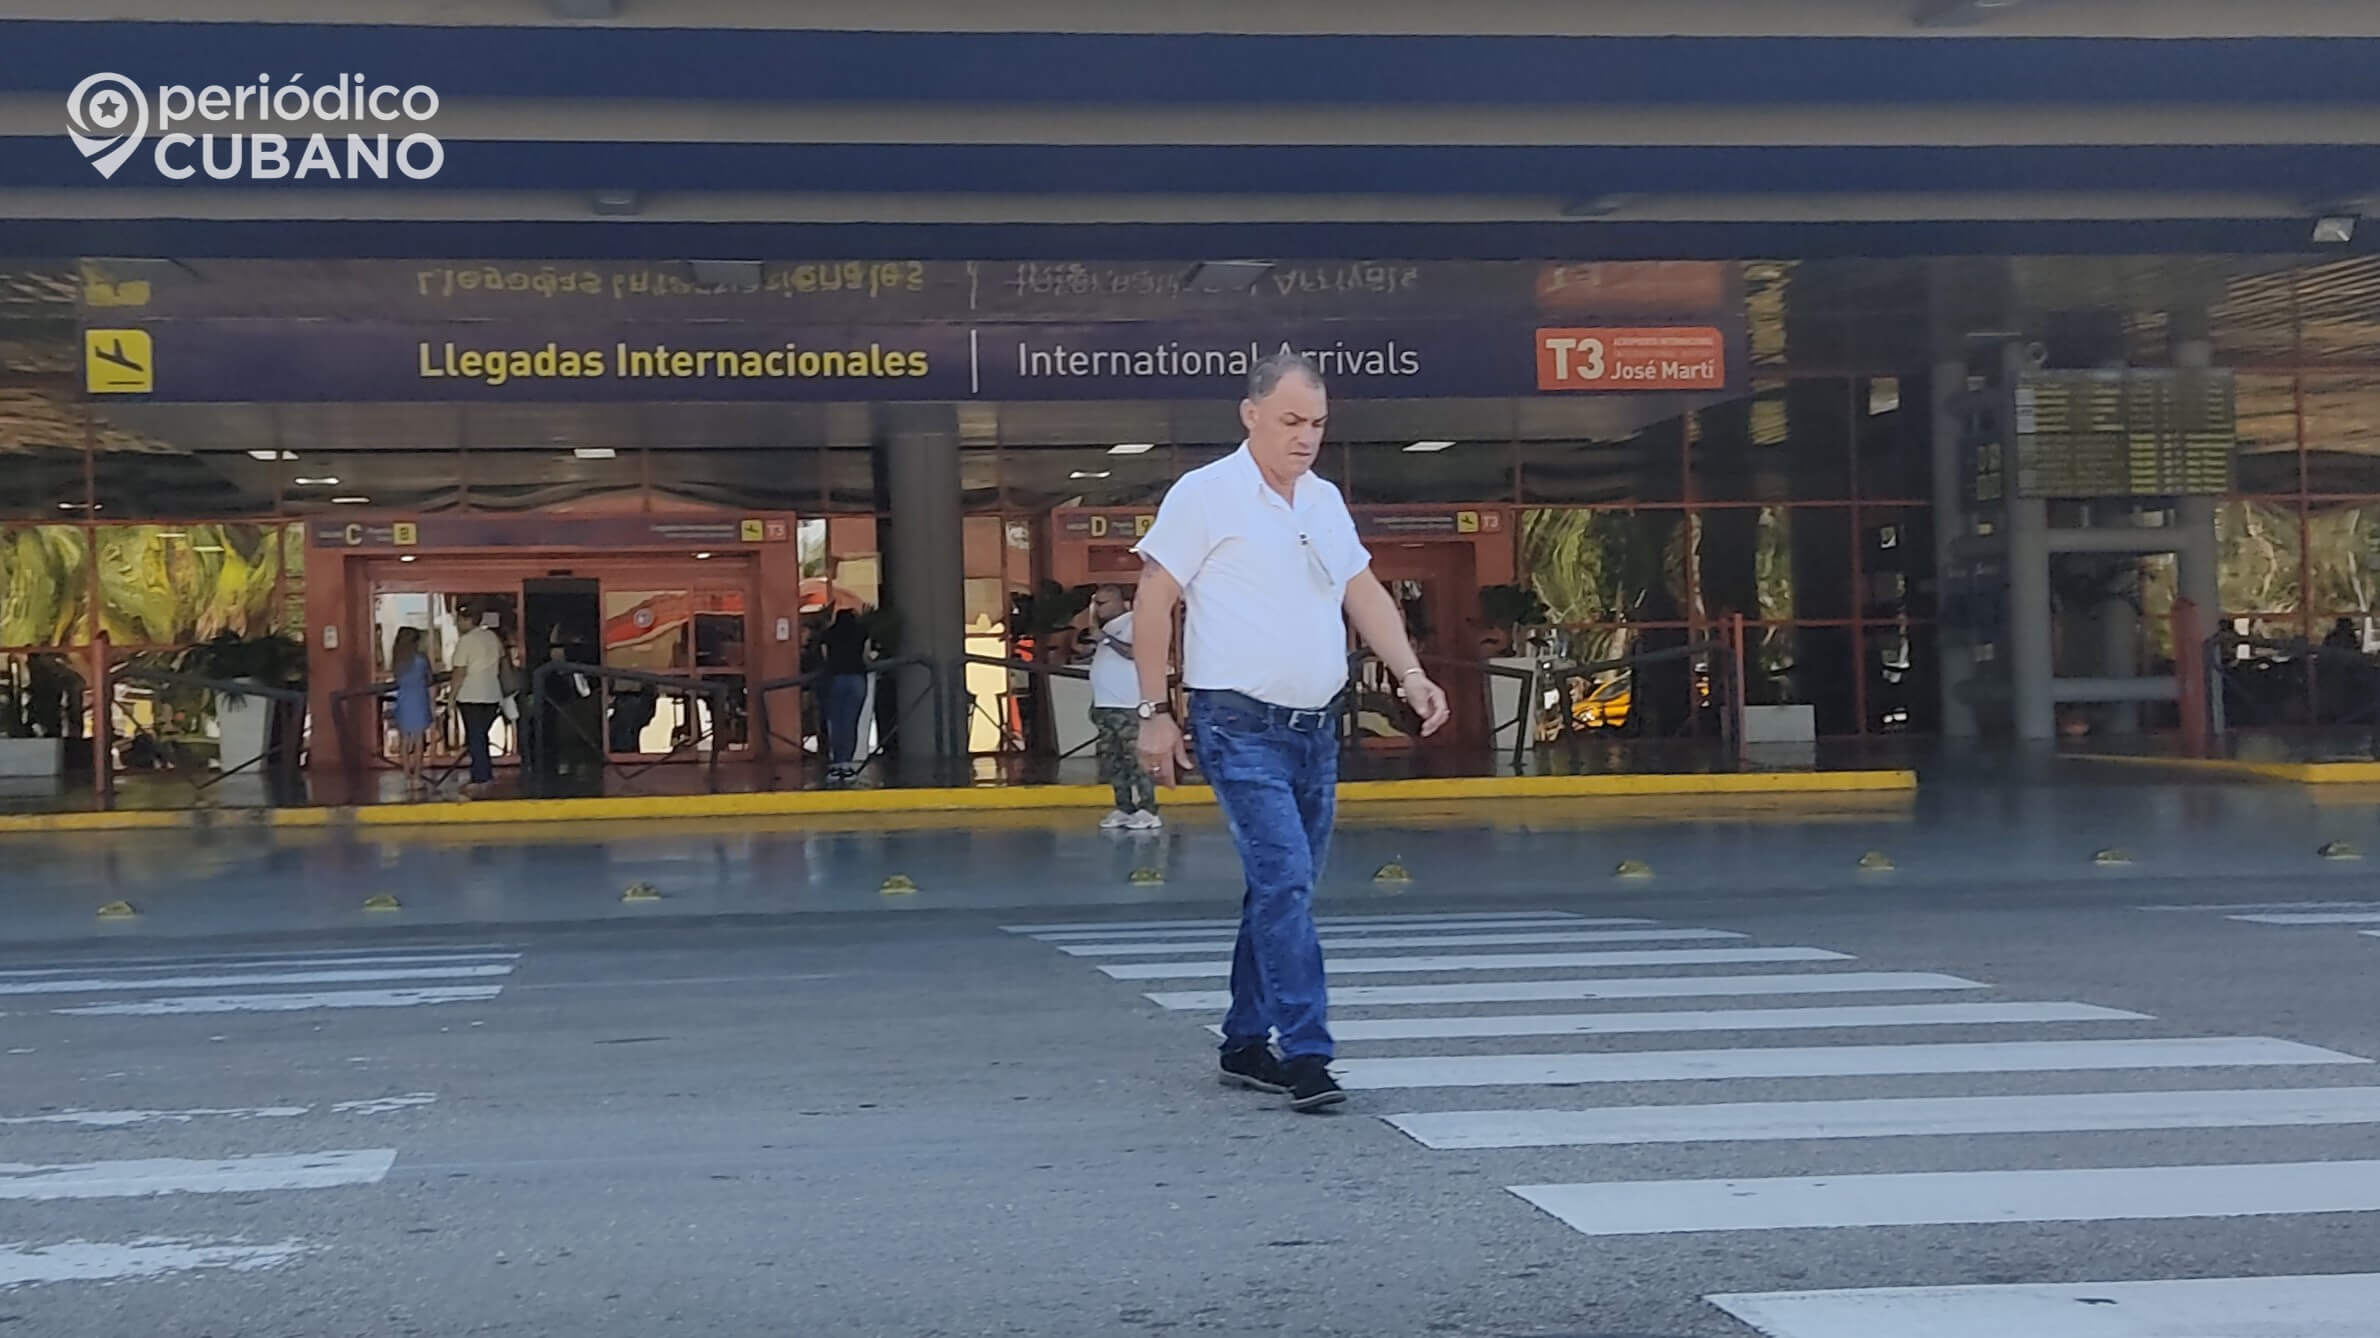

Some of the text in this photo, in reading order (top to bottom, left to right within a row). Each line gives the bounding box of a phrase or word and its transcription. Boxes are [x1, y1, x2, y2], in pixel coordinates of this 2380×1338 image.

[418, 342, 929, 385] Llegadas Internacionales
[1018, 341, 1258, 375] International
[1545, 338, 1605, 380] T3
[1610, 360, 1715, 380] José Martí
[345, 524, 362, 545] C
[1091, 516, 1106, 536] D
